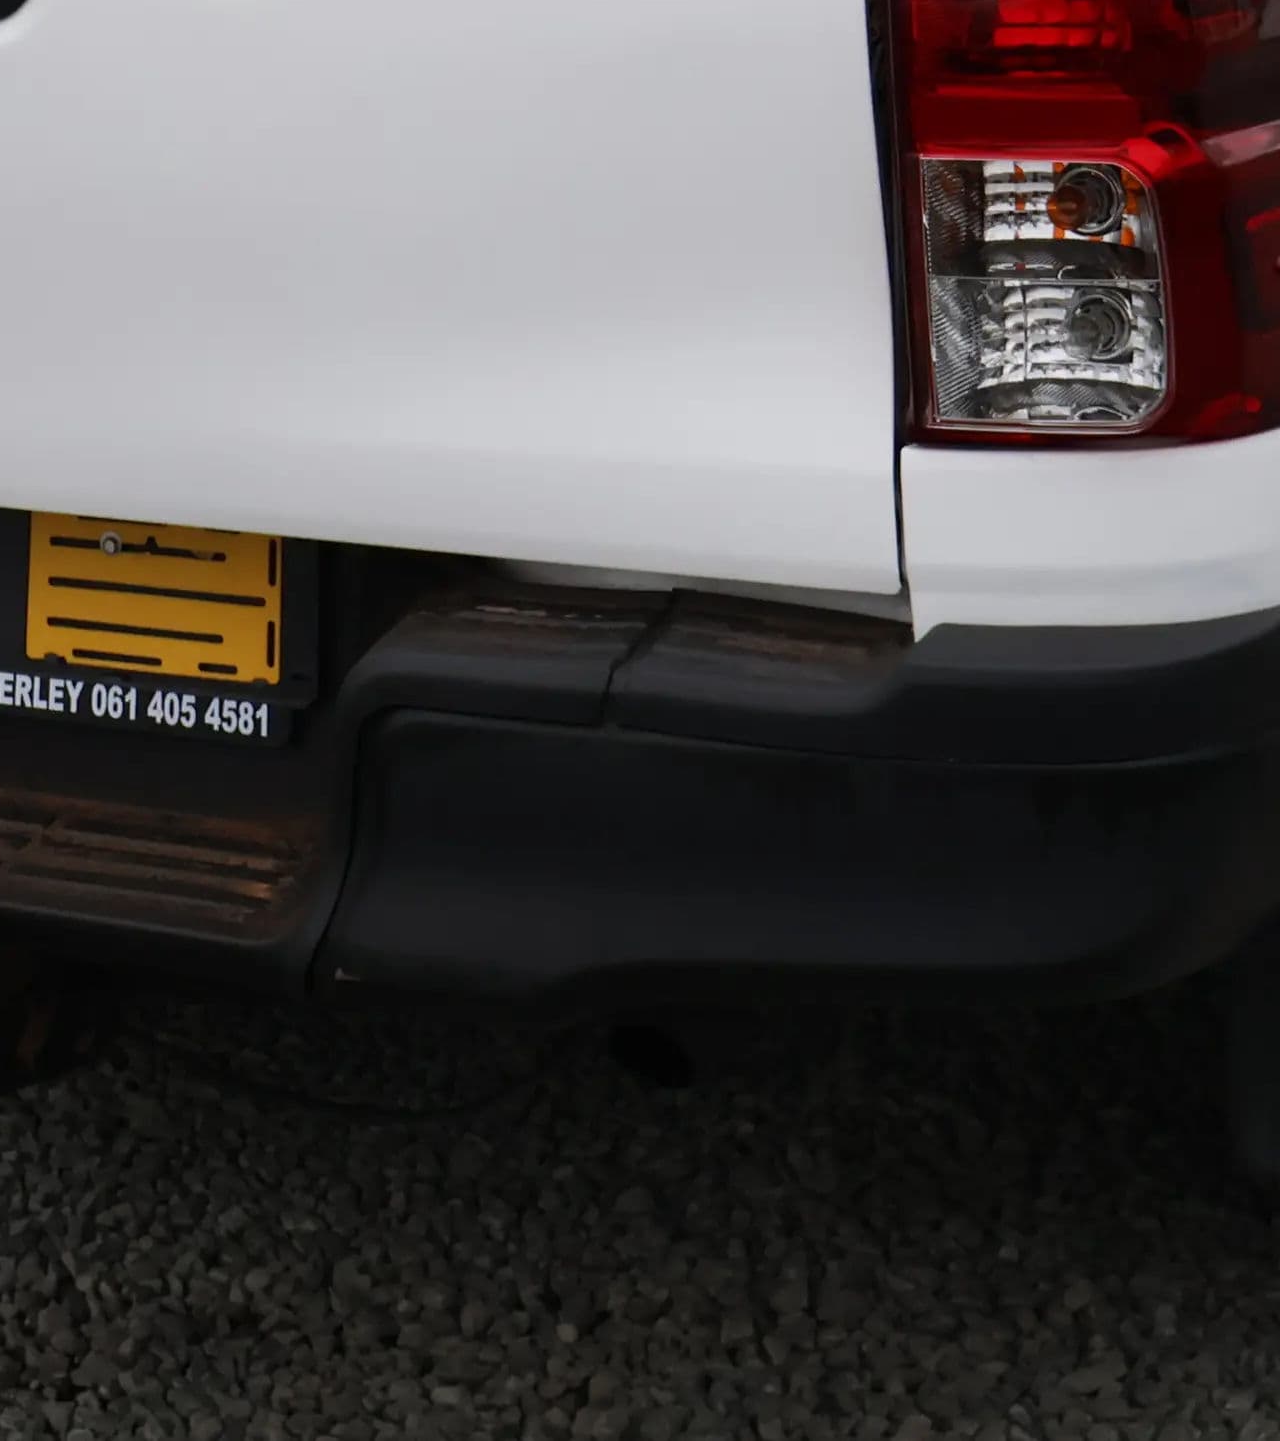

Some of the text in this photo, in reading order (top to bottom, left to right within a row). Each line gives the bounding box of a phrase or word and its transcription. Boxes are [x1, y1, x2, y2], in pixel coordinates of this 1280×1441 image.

[90, 682, 138, 720] 061
[147, 690, 197, 728] 405
[204, 697, 269, 737] 4581
